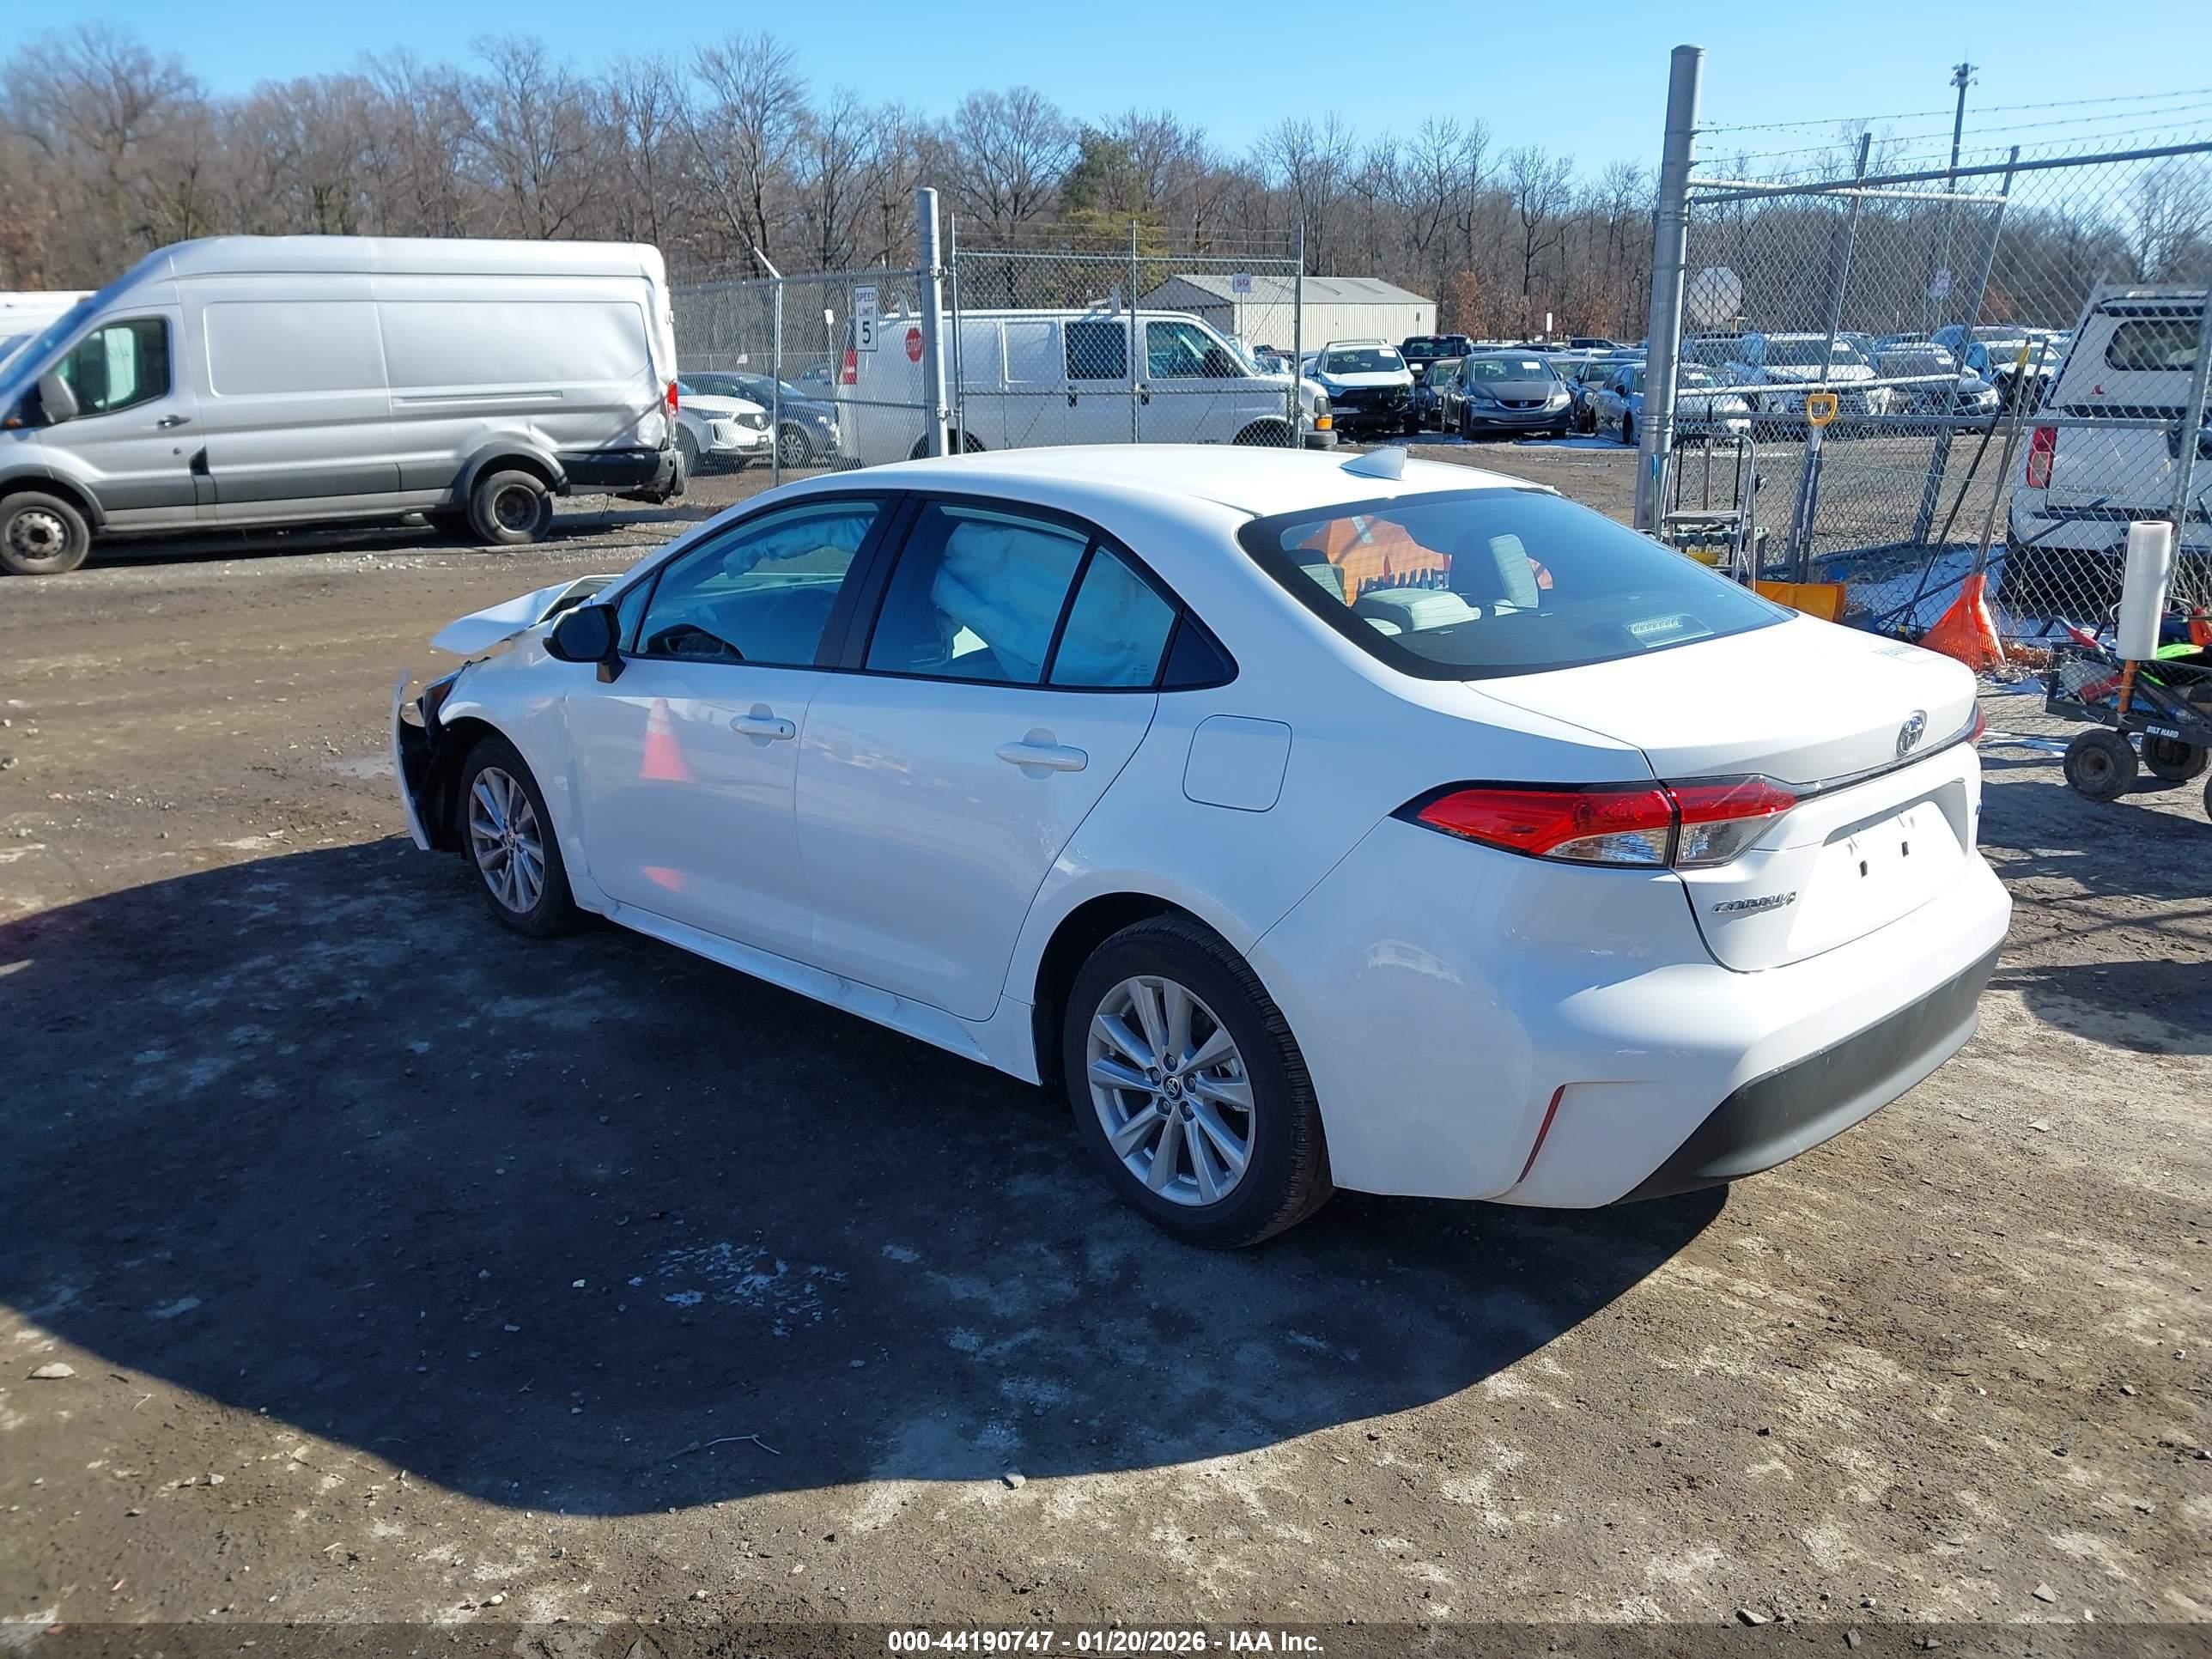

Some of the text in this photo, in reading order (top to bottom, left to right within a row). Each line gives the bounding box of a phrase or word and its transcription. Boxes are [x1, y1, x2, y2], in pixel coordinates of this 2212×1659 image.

[856, 292, 875, 302] SPEED
[859, 307, 873, 317] LIMIT
[862, 320, 871, 344] 5
[906, 337, 922, 353] STOP
[2146, 725, 2179, 738] BILT HARD
